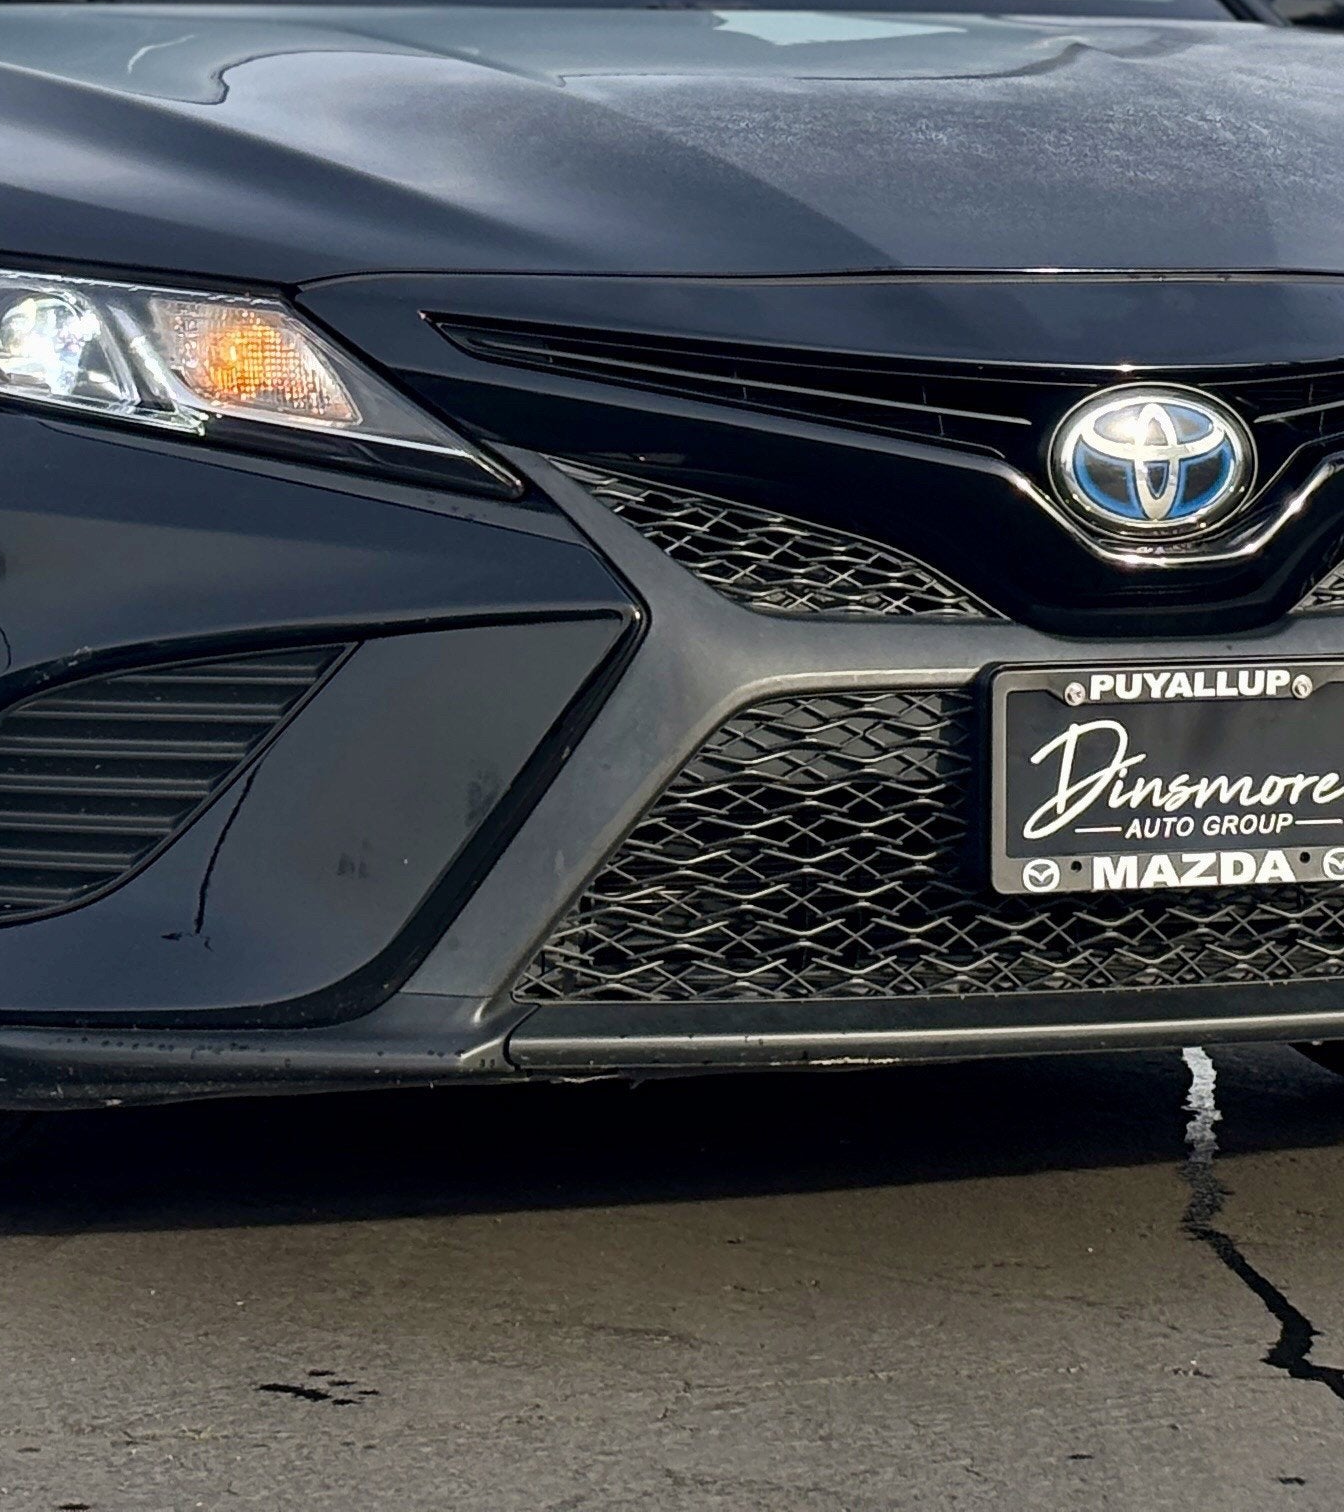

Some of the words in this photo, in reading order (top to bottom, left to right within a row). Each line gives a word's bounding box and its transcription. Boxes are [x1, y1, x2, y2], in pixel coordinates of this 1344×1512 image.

[1089, 670, 1291, 700] PUYALLUP
[1125, 817, 1196, 839] AUTO
[1202, 813, 1295, 836] GROUP
[1093, 850, 1297, 890] MAZDA
